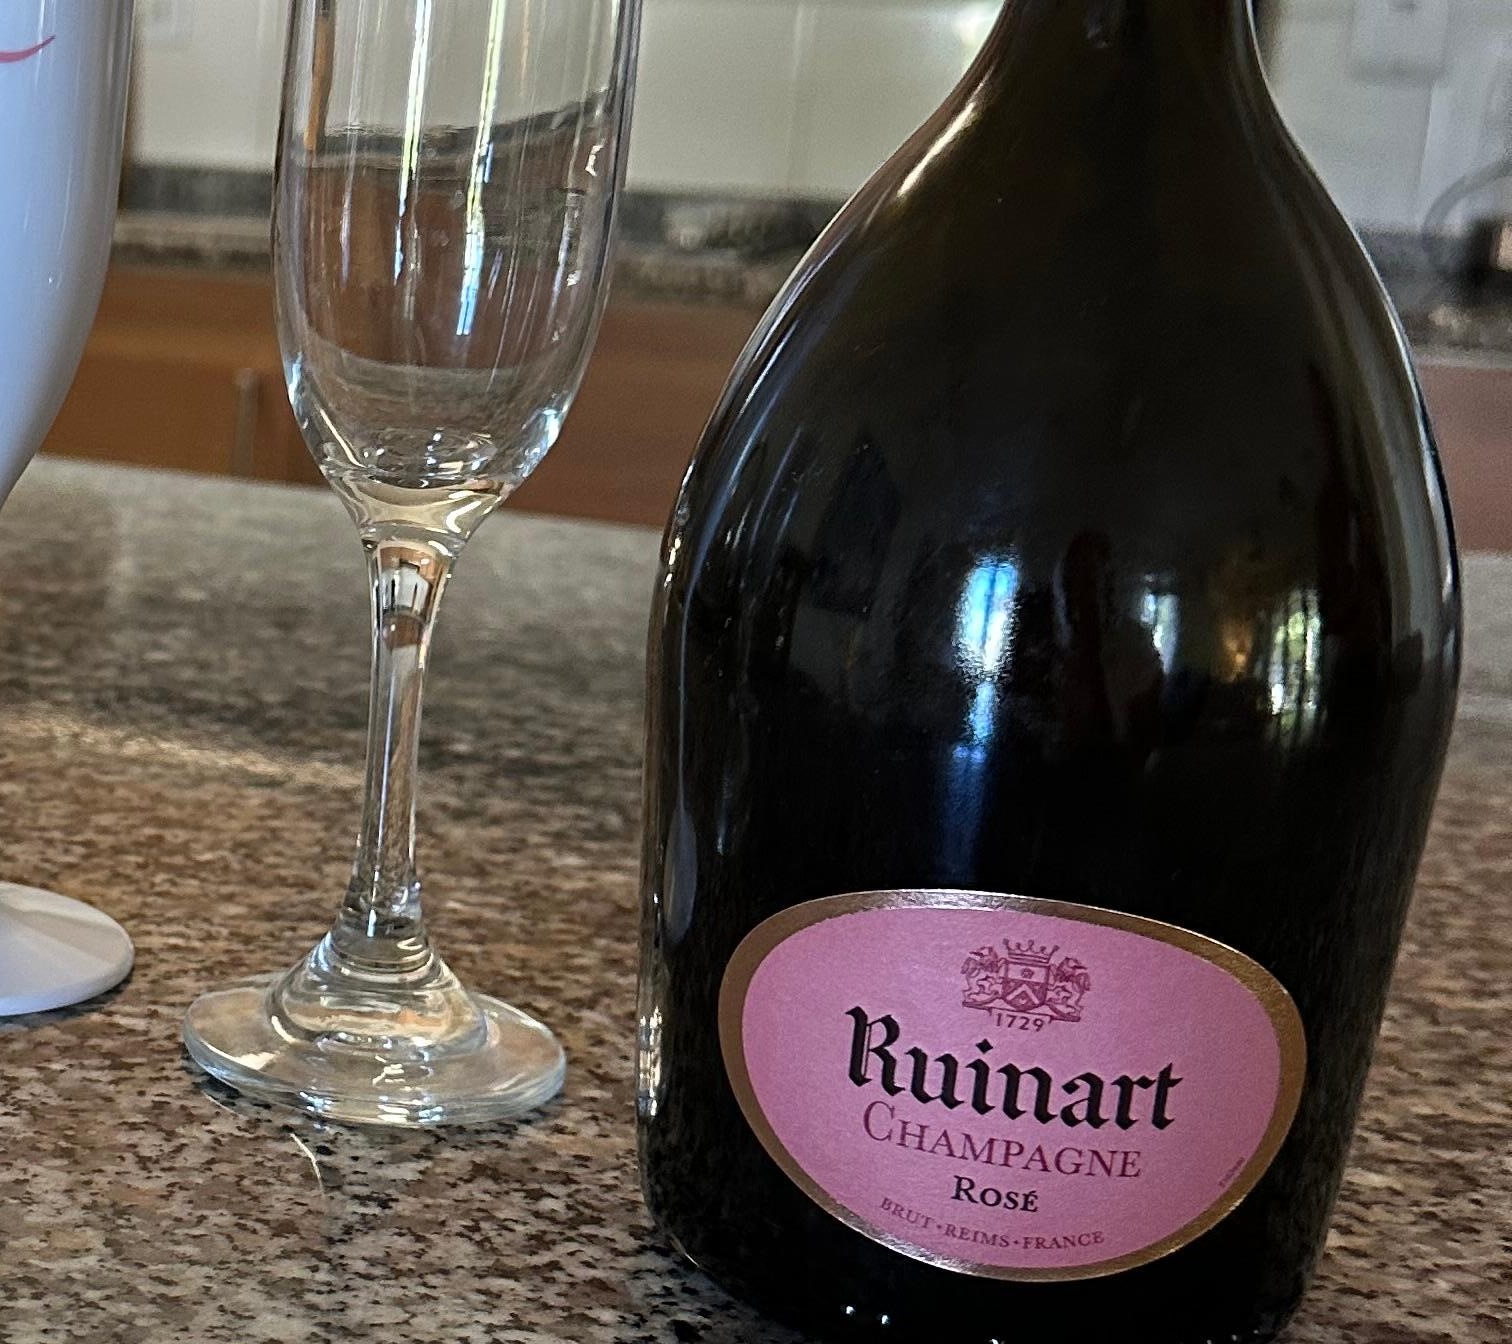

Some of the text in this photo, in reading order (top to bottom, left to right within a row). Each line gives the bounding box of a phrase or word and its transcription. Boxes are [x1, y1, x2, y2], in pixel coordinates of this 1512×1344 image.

[996, 1012, 1045, 1033] 1729
[844, 1005, 1184, 1131] Ruinart
[862, 1100, 1142, 1178] CHAMPAGNE
[951, 1174, 1039, 1213] ROSÉ
